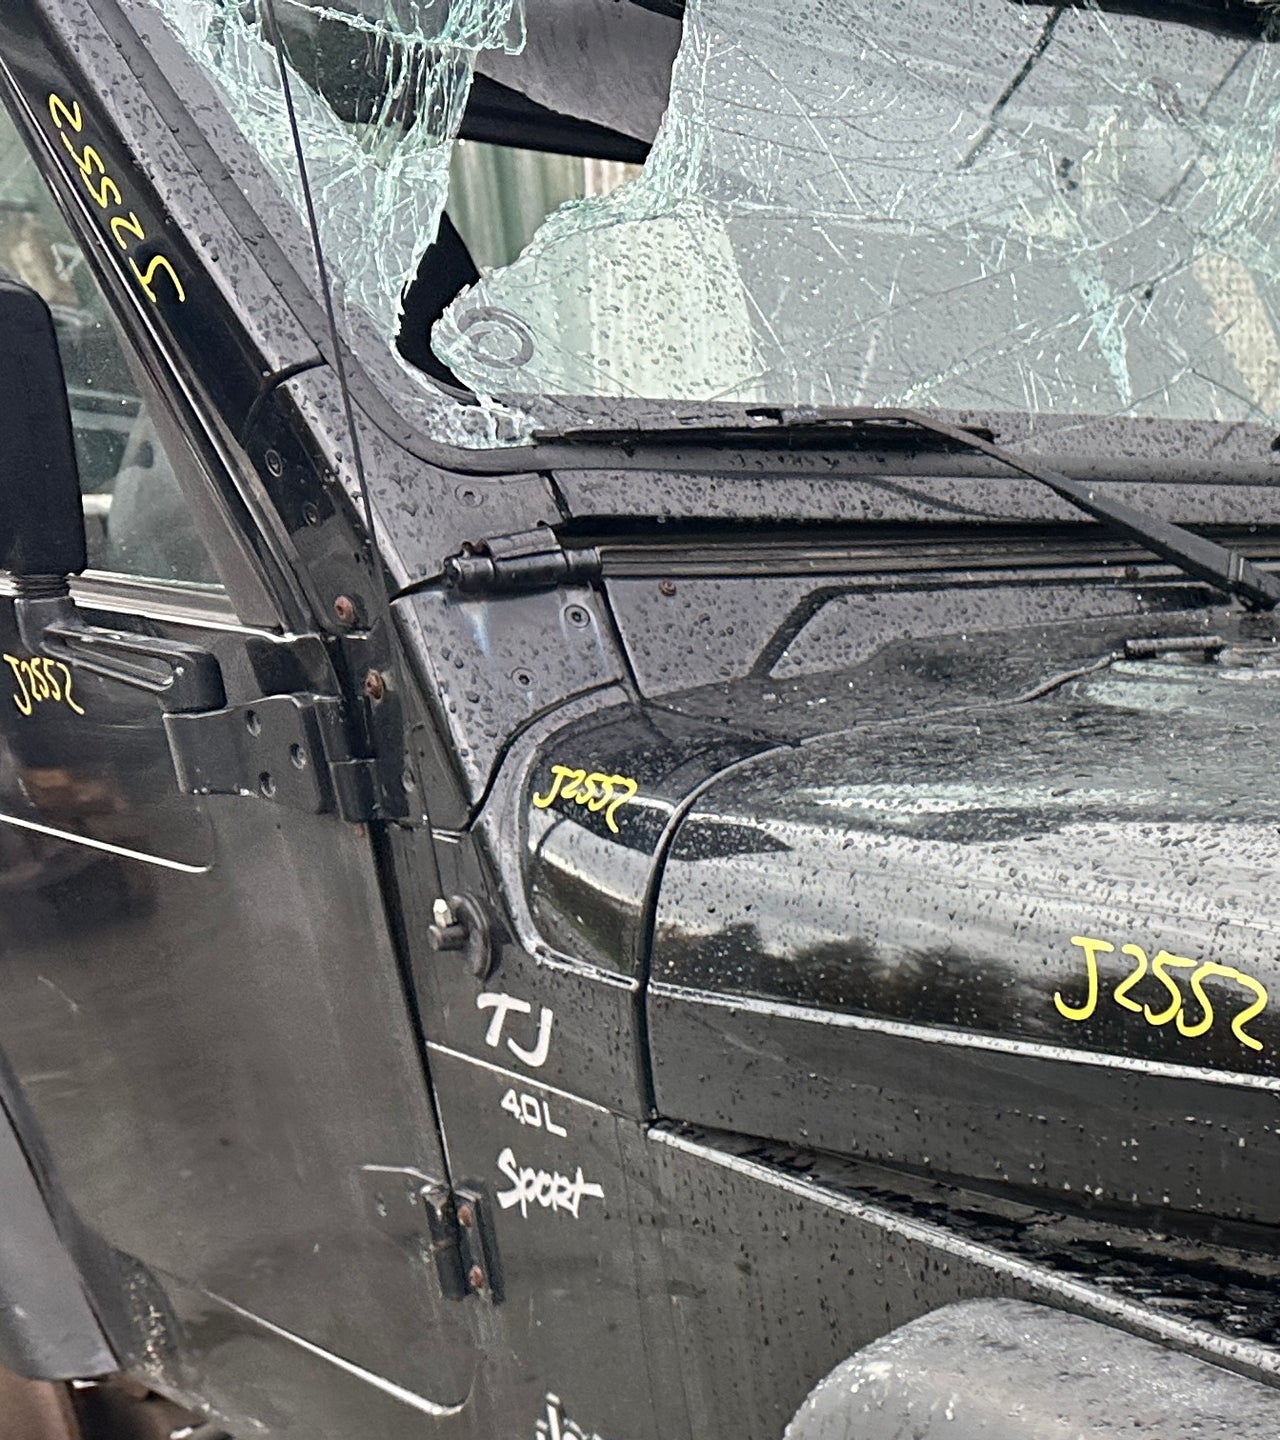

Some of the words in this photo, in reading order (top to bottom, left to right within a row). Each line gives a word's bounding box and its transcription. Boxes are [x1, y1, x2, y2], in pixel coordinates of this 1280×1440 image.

[48, 93, 186, 303] J2552
[3, 653, 85, 715] J2552
[532, 765, 638, 833] J2552
[476, 992, 553, 1067] TJ
[1053, 935, 1269, 1051] J2552
[497, 1147, 605, 1219] Sport
